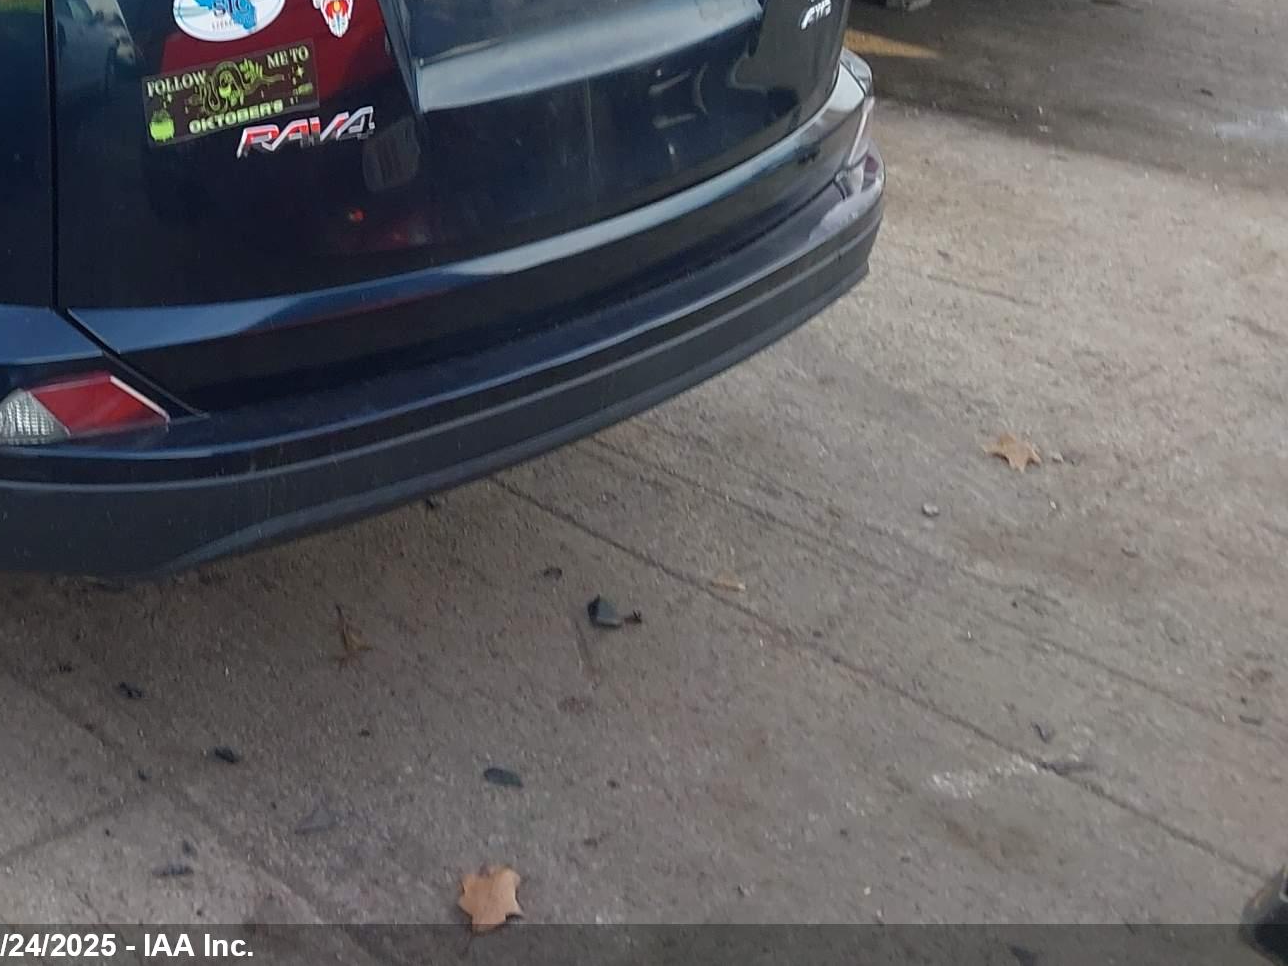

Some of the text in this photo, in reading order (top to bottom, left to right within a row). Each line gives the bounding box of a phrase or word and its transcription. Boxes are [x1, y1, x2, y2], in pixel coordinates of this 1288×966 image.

[147, 45, 309, 98] FOLLOW ME TO
[236, 106, 375, 158] RAV4
